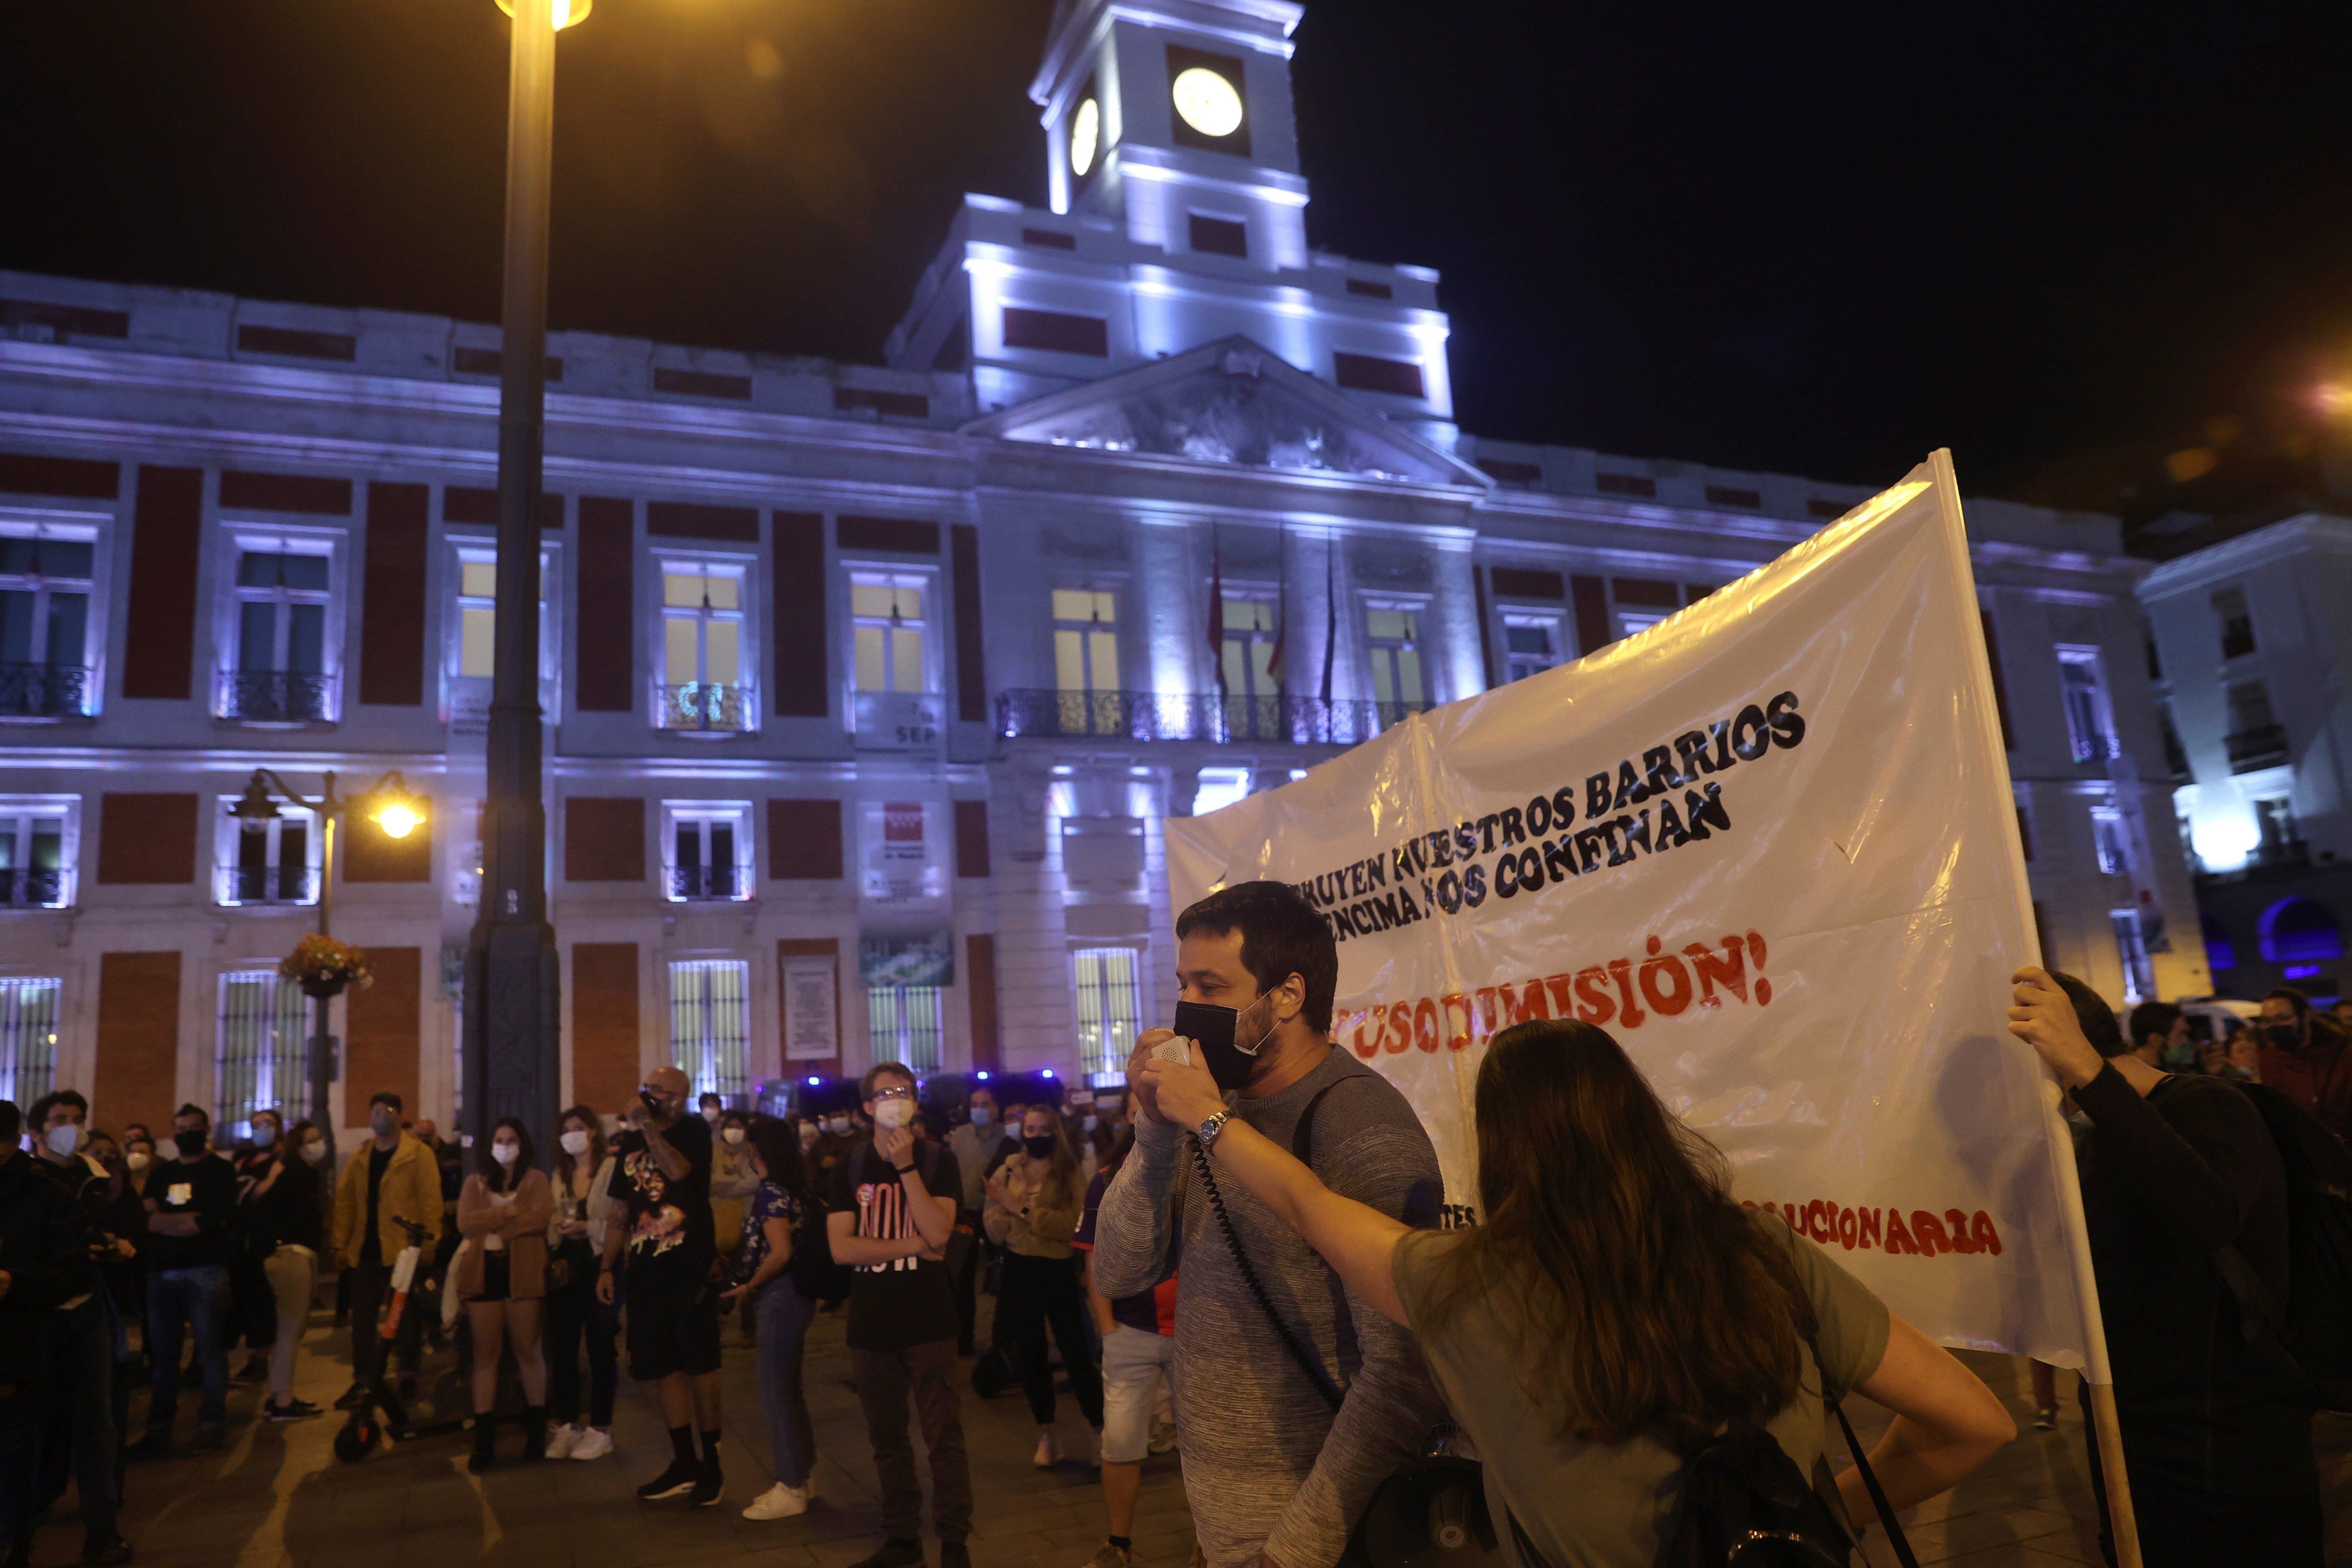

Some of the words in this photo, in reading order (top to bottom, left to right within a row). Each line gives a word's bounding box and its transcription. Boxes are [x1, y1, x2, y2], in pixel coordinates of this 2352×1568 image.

[1391, 787, 1575, 881] NUESTROS
[1585, 691, 1805, 819] BARRIOS
[1421, 864, 1487, 918] NOS
[1494, 781, 1730, 898] CONFINAN
[1329, 997, 1439, 1059] YUSO
[1441, 931, 1772, 1051] DIMISIÓN!
[1441, 1204, 1476, 1229] TES
[1742, 1199, 2002, 1258] UCIONARIA
